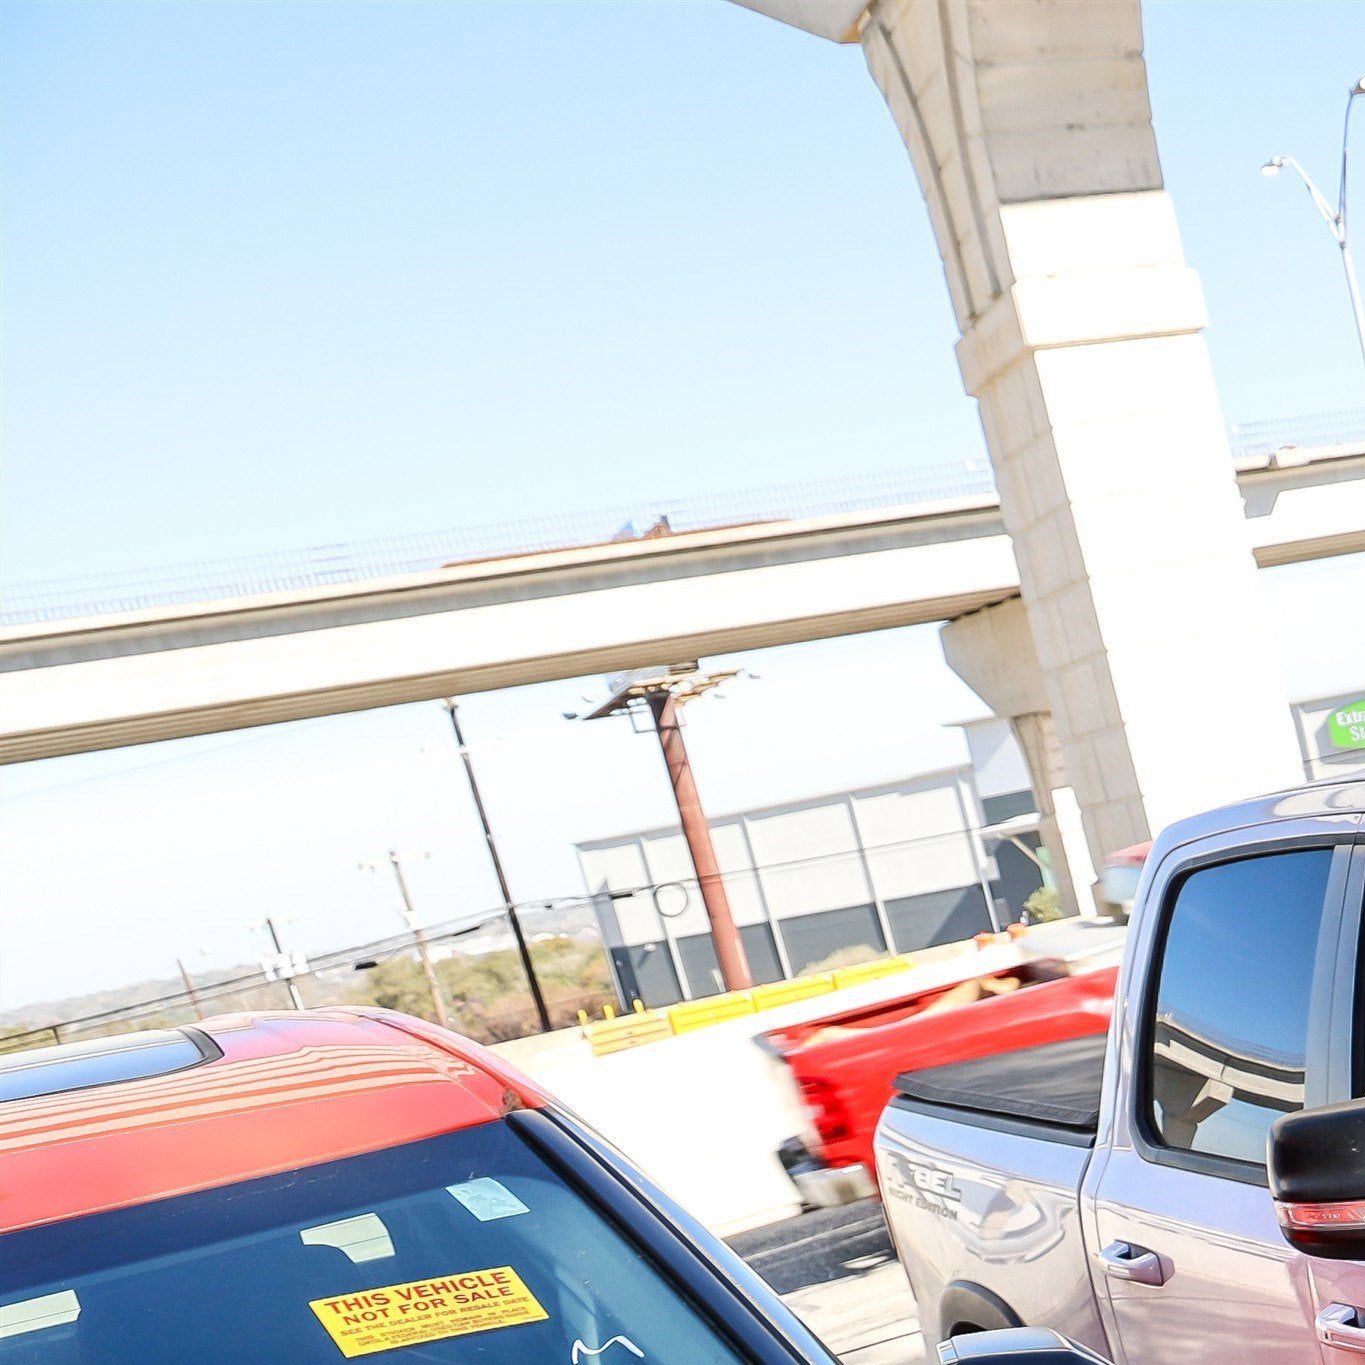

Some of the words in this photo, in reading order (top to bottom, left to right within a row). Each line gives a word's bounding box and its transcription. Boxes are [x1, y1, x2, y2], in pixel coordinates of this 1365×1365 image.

[325, 1293, 391, 1315] THIS
[395, 1272, 511, 1301] VEHICLE
[342, 1308, 390, 1326] NOT
[398, 1298, 448, 1315] FOR
[454, 1286, 514, 1304] SALE
[341, 1327, 363, 1337] SEE
[366, 1322, 387, 1331] THE
[389, 1313, 432, 1326] DEALER
[435, 1310, 457, 1318] FOR
[460, 1301, 501, 1313] RESALE
